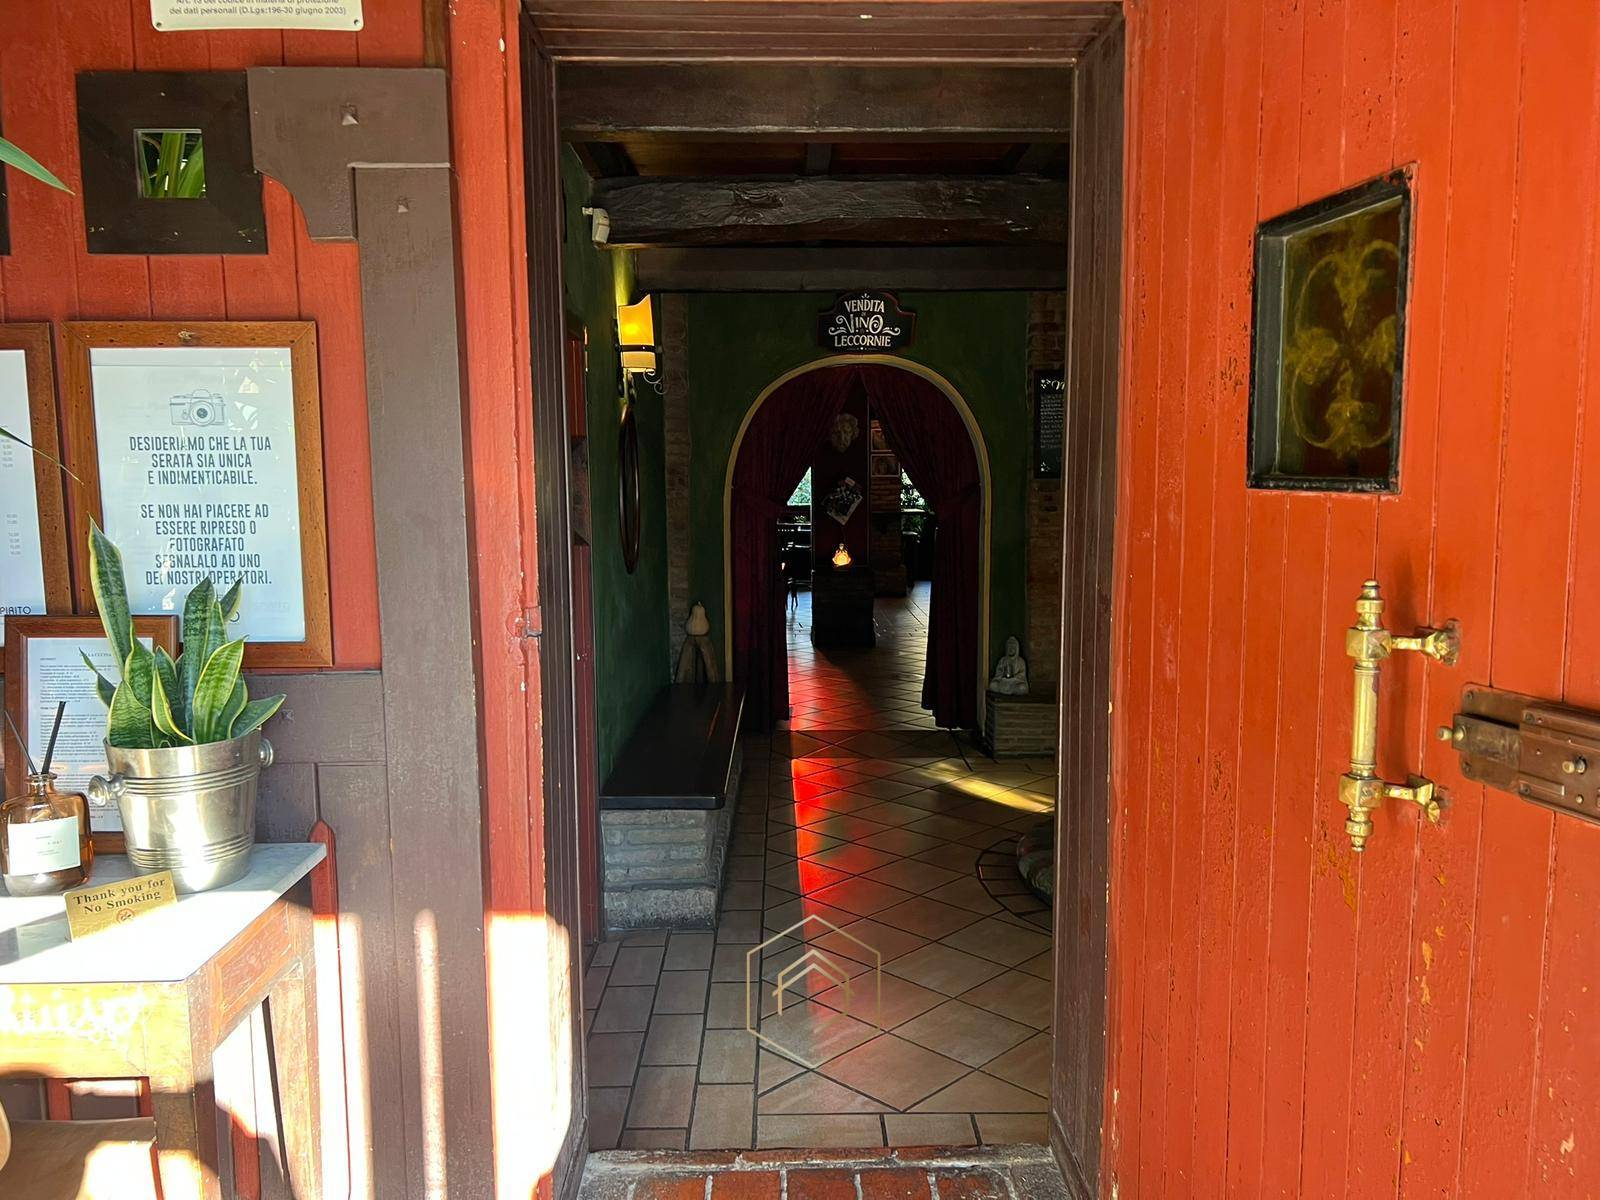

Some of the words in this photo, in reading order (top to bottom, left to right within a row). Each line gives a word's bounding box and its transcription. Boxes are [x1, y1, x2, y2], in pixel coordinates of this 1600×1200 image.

[184, 6, 199, 14] dati
[200, 7, 237, 15] personali
[295, 7, 323, 15] giugno
[844, 299, 885, 313] VENDITA
[835, 313, 884, 334] VINO
[834, 334, 892, 347] LECCORNIE
[129, 436, 205, 451] DESIDERIAMO
[208, 436, 229, 451] CHE
[233, 436, 247, 451] LA
[250, 436, 272, 451] TUA
[151, 453, 194, 468] SERATA
[196, 453, 215, 468] SIA
[218, 453, 252, 468] UNICA
[148, 470, 154, 485] E
[158, 470, 258, 485] INDIMENTICABILE.
[140, 503, 155, 518] SE
[158, 503, 180, 518] NON
[184, 503, 202, 518] HAI
[206, 503, 250, 518] PIACERE
[254, 503, 269, 518] AD
[155, 520, 196, 535] ESSERE
[200, 520, 246, 535] RIPRESO
[249, 520, 257, 535] O
[169, 537, 245, 552] FOTOGRAFATO
[221, 554, 235, 568] AD
[239, 554, 261, 568] UNO
[167, 570, 206, 585] NOSTRI
[210, 570, 272, 585] OPERATORI.
[73, 888, 116, 905] Thank
[120, 882, 142, 897] you
[147, 878, 166, 889] for
[84, 904, 102, 915] No
[106, 891, 161, 910] Smoking
